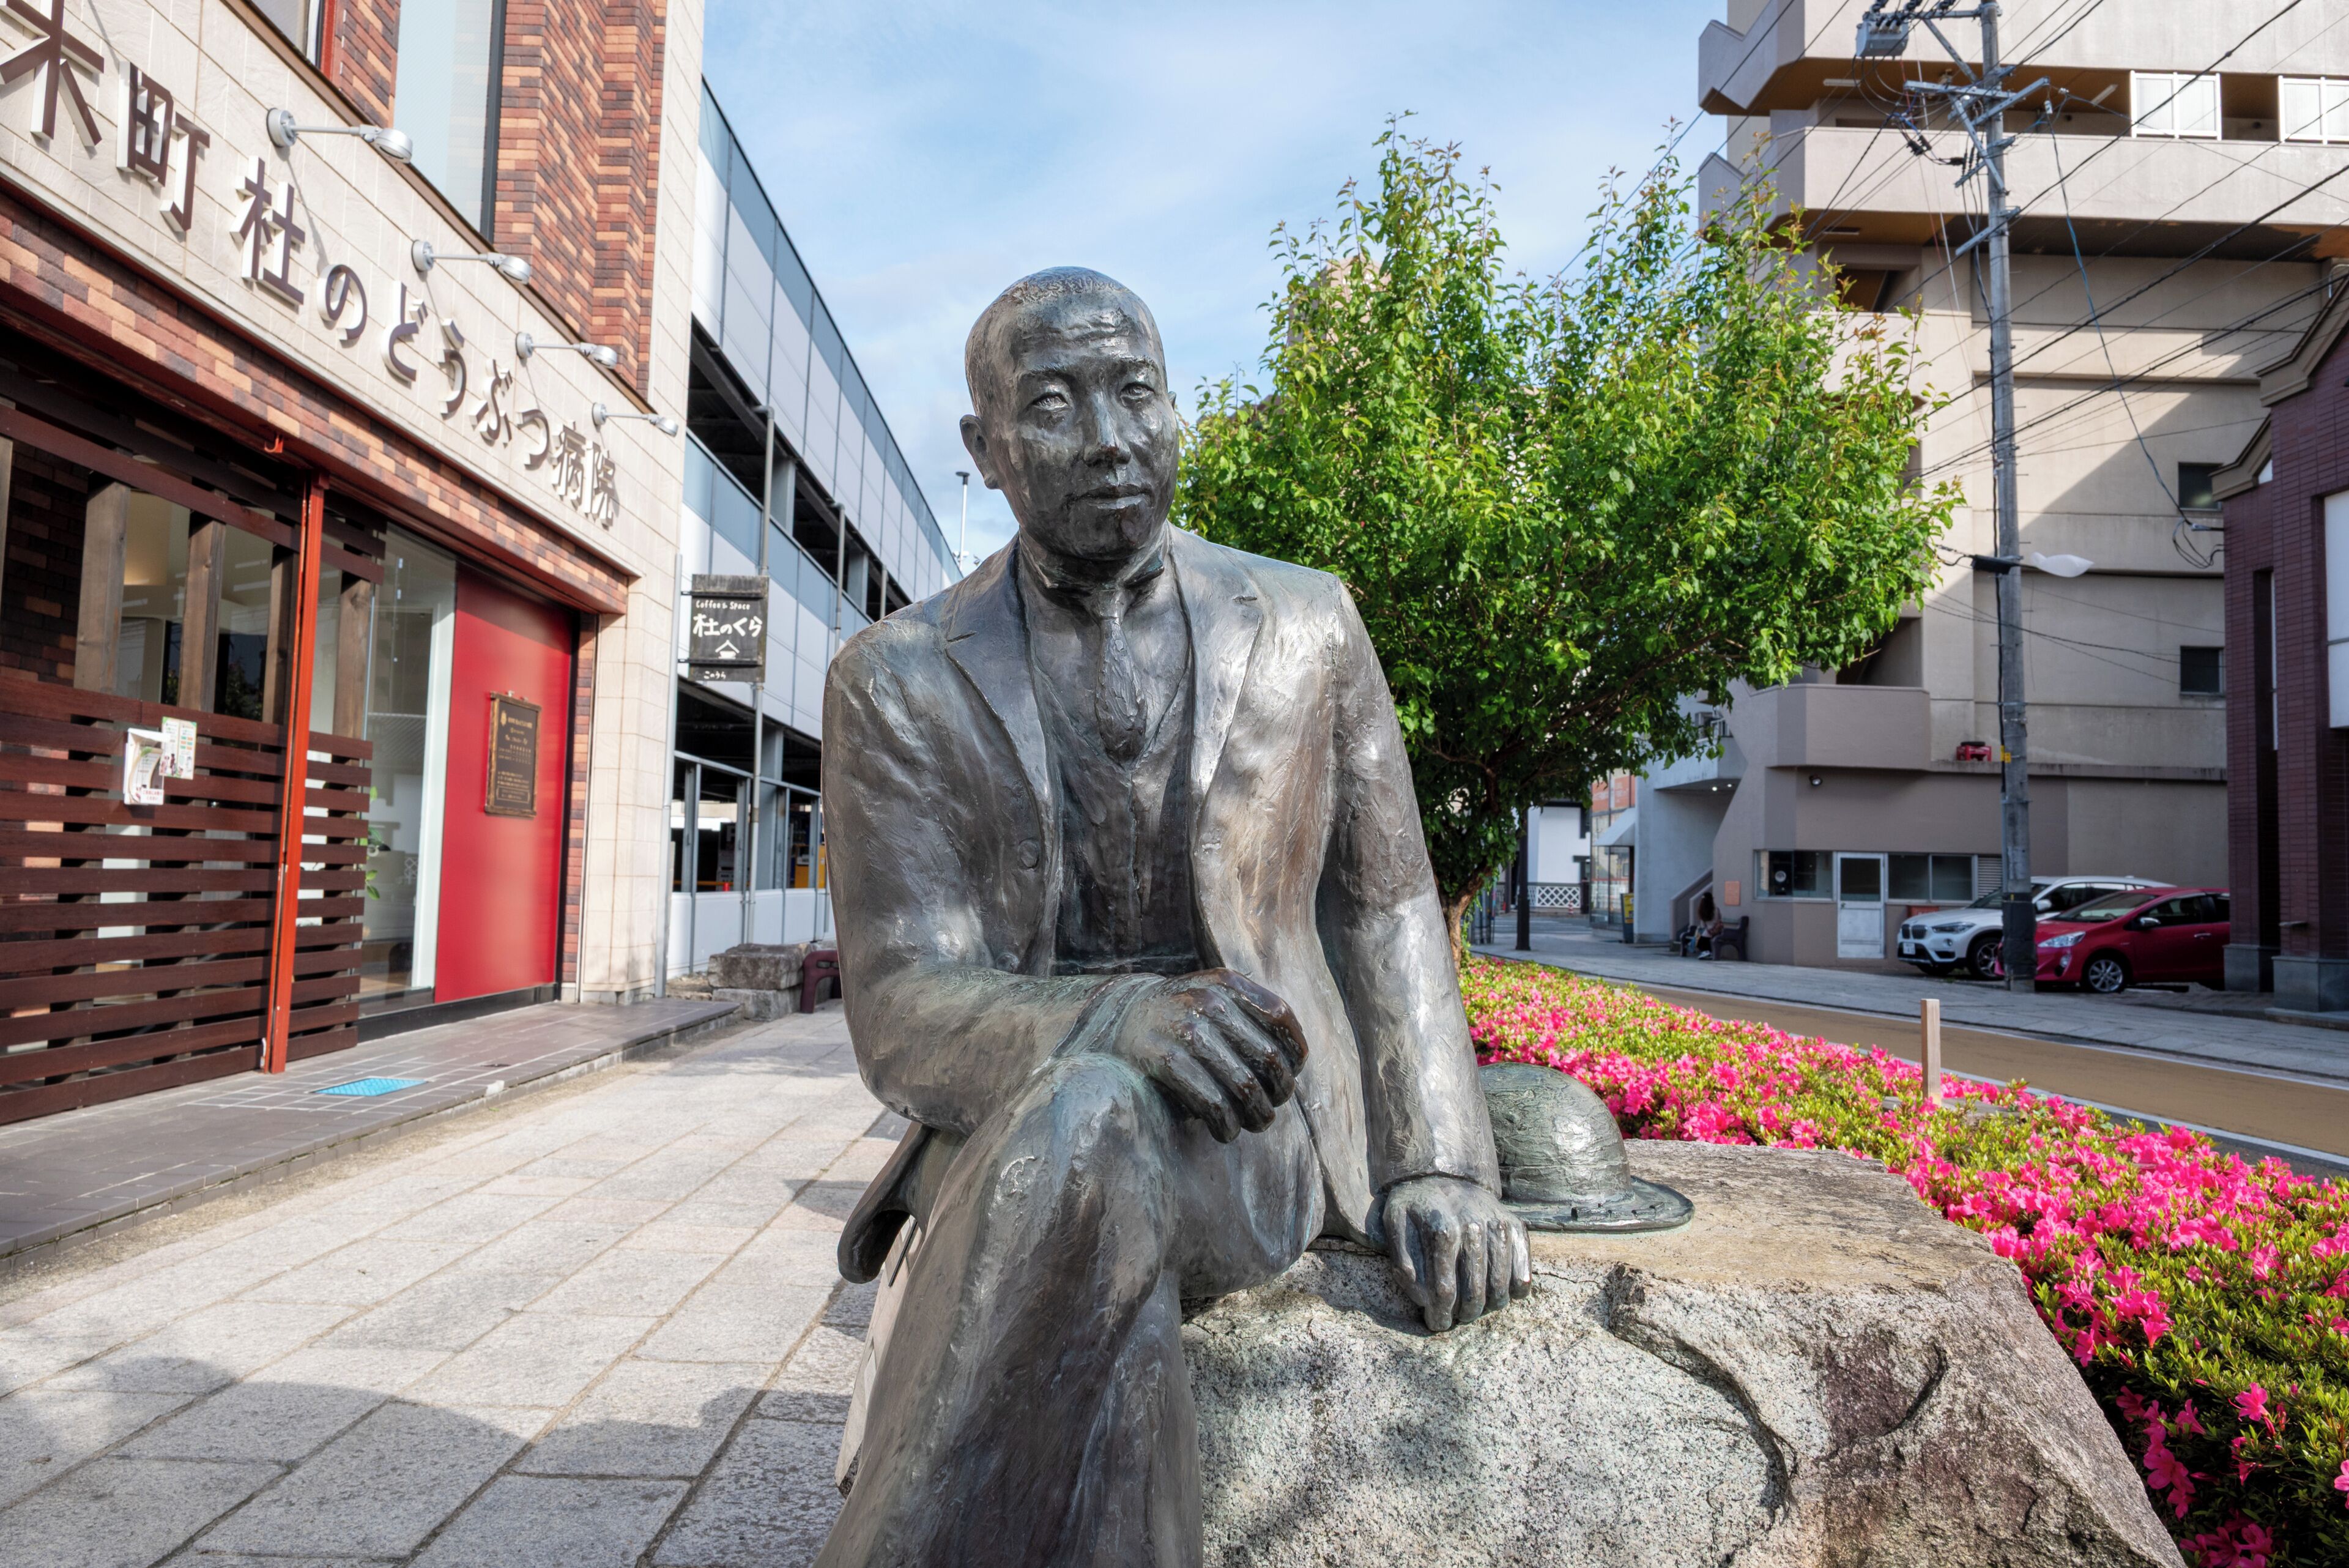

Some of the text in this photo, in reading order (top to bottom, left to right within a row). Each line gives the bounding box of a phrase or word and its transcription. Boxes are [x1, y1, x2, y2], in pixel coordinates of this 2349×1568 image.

[696, 600, 721, 609] Coffee
[692, 613, 763, 637] 杜のくら
